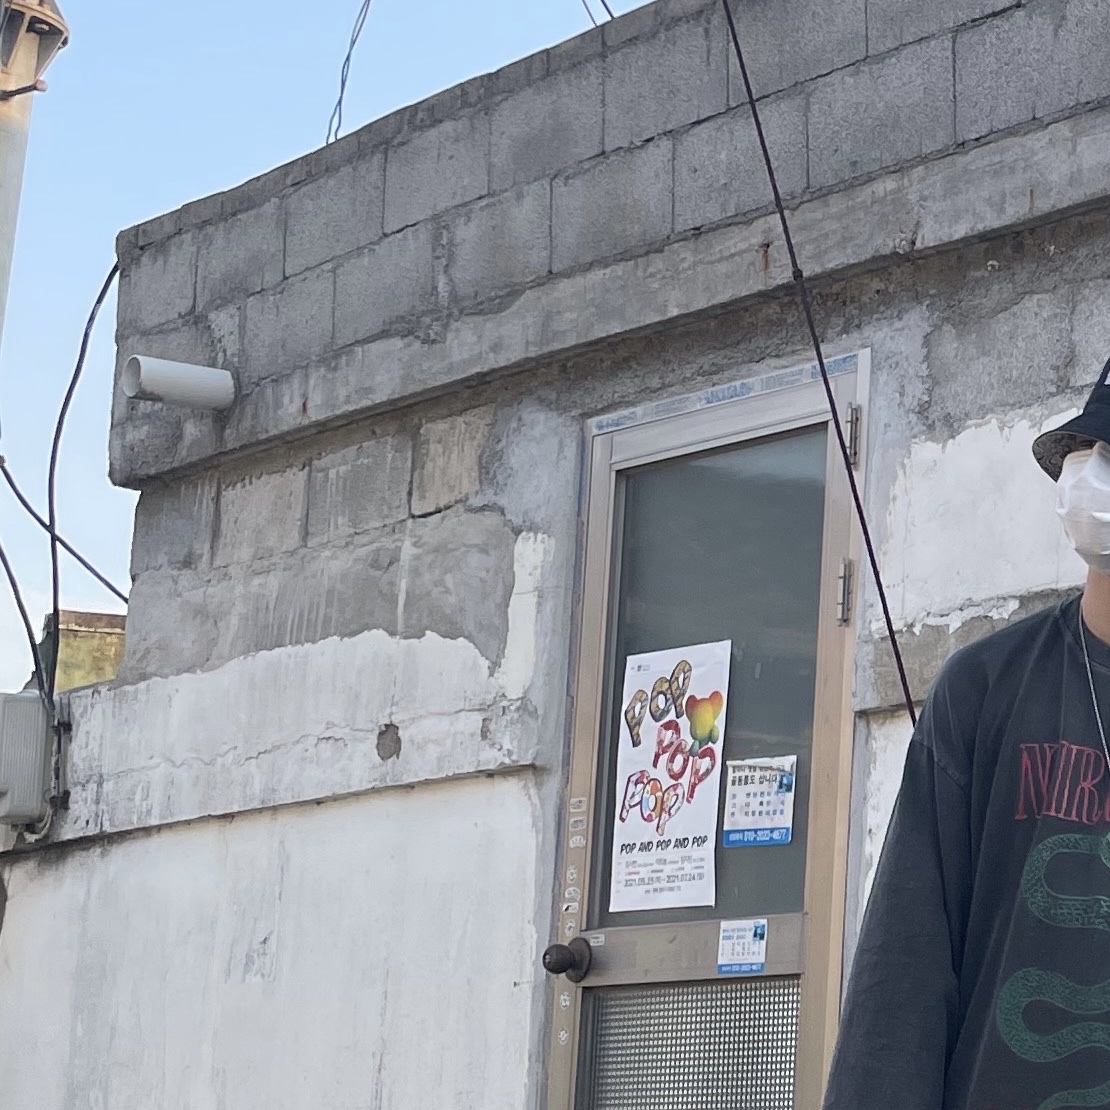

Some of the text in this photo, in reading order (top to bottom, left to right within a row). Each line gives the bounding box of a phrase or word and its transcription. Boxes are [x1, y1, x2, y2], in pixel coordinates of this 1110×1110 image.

[620, 834, 708, 855] POP AND POP AND POP
